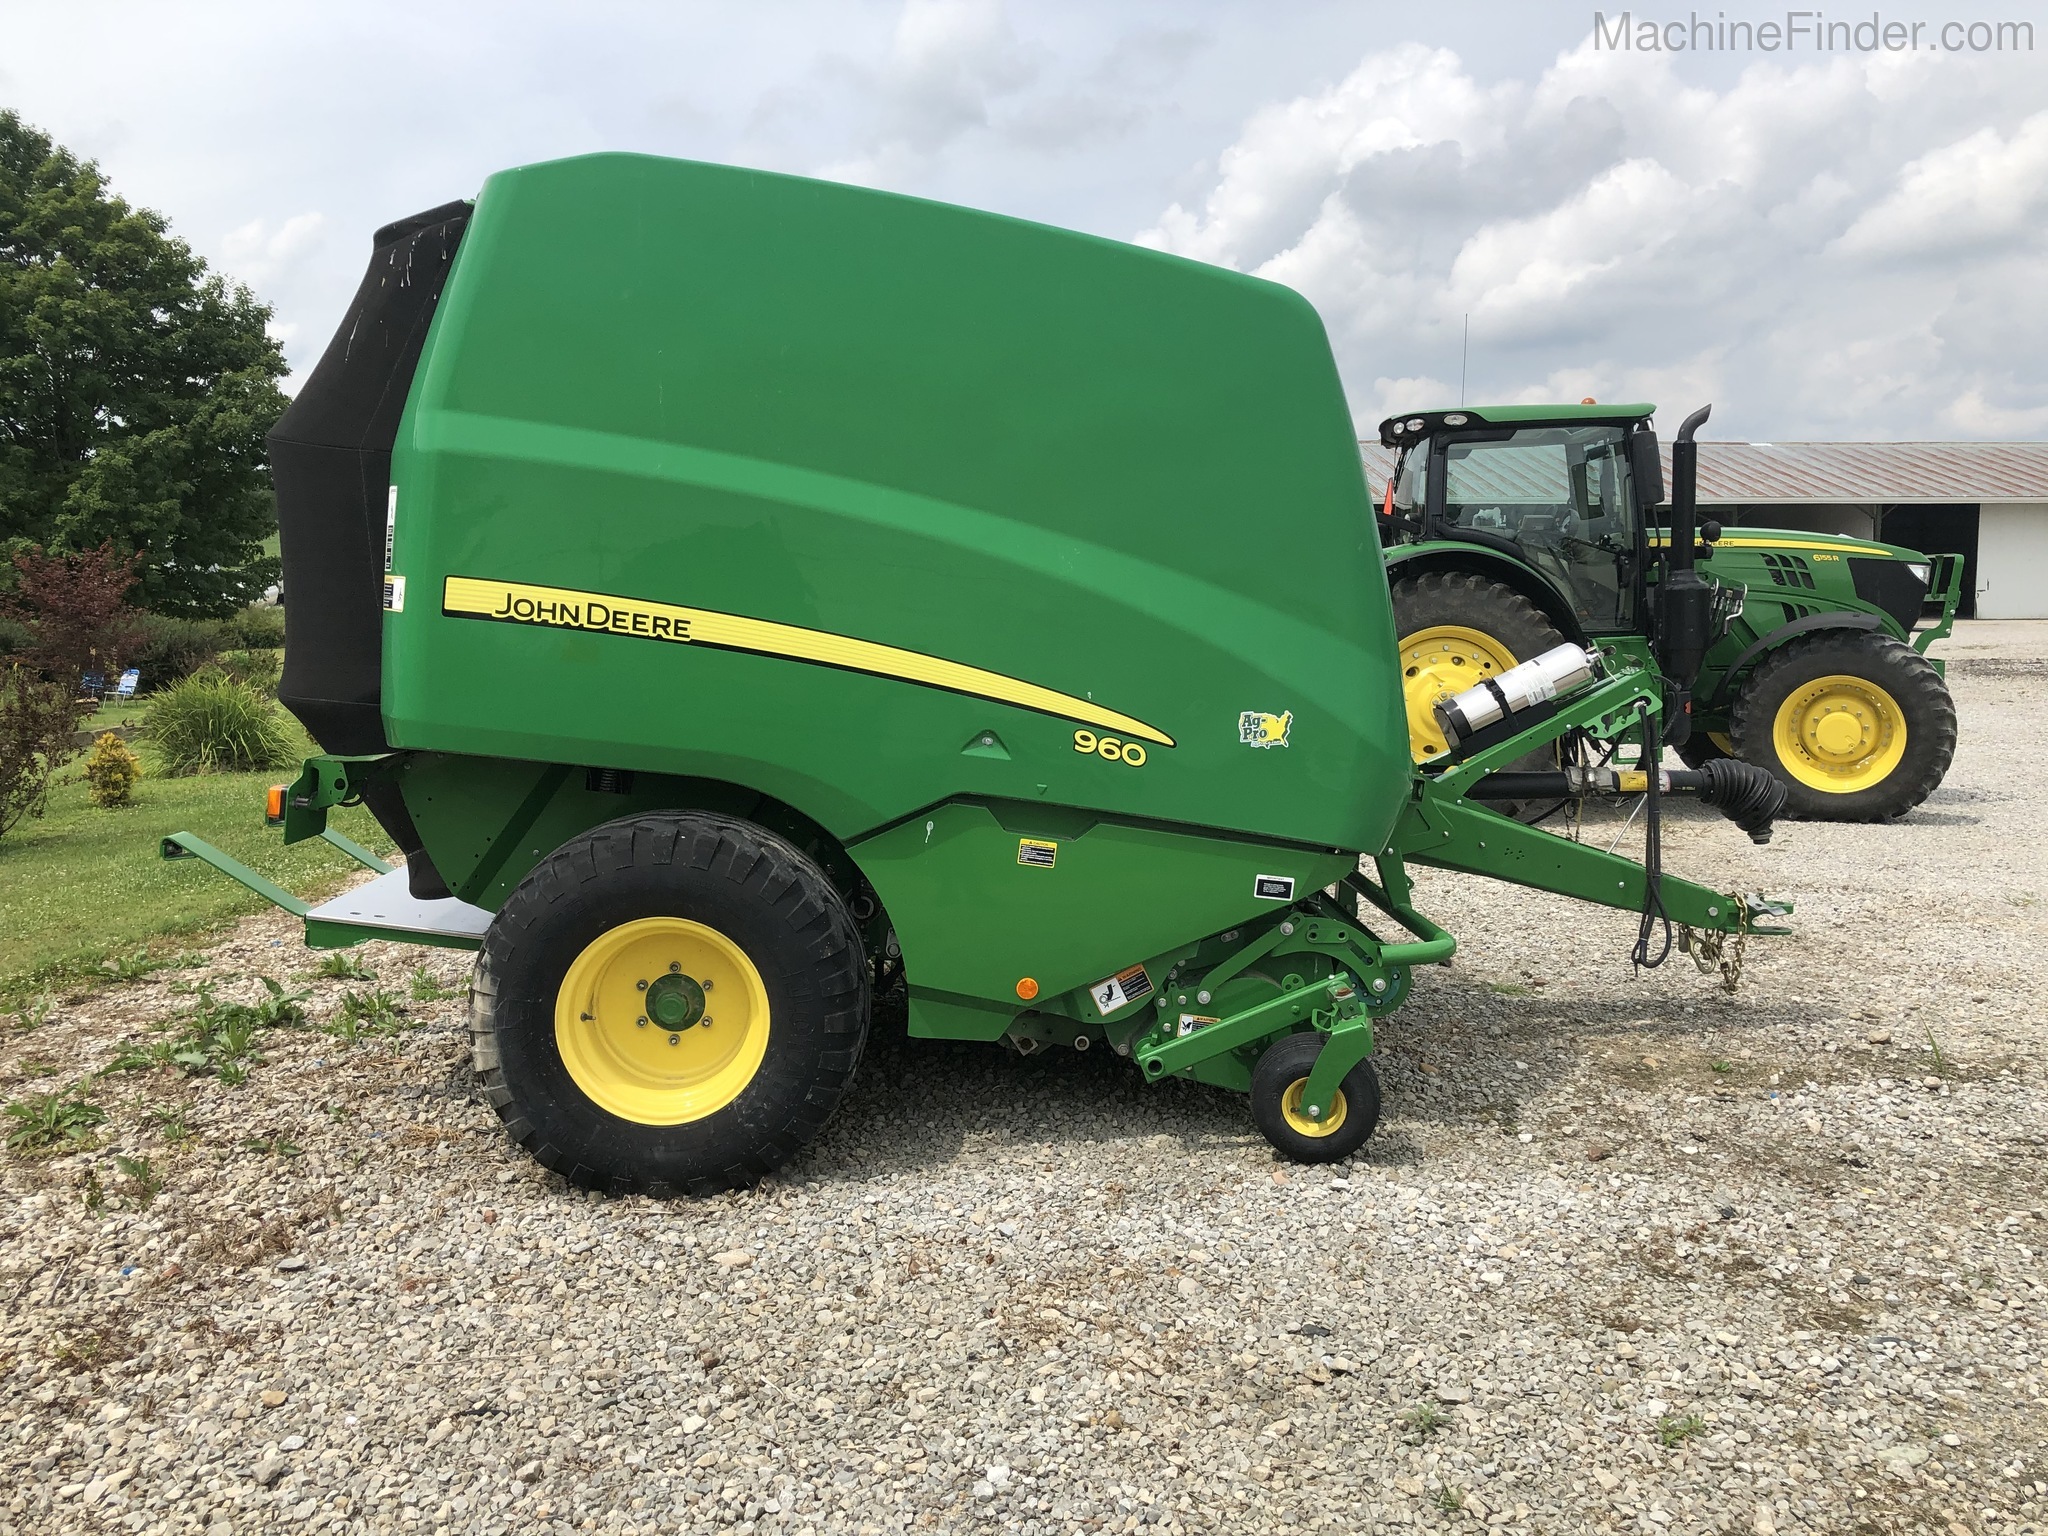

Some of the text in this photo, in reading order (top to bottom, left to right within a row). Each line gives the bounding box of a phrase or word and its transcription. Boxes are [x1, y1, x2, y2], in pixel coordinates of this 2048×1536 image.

[495, 592, 692, 639] JOHN DEERE
[1242, 714, 1266, 729] Ag-
[1242, 727, 1268, 740] Pro
[1073, 729, 1148, 768] 960
